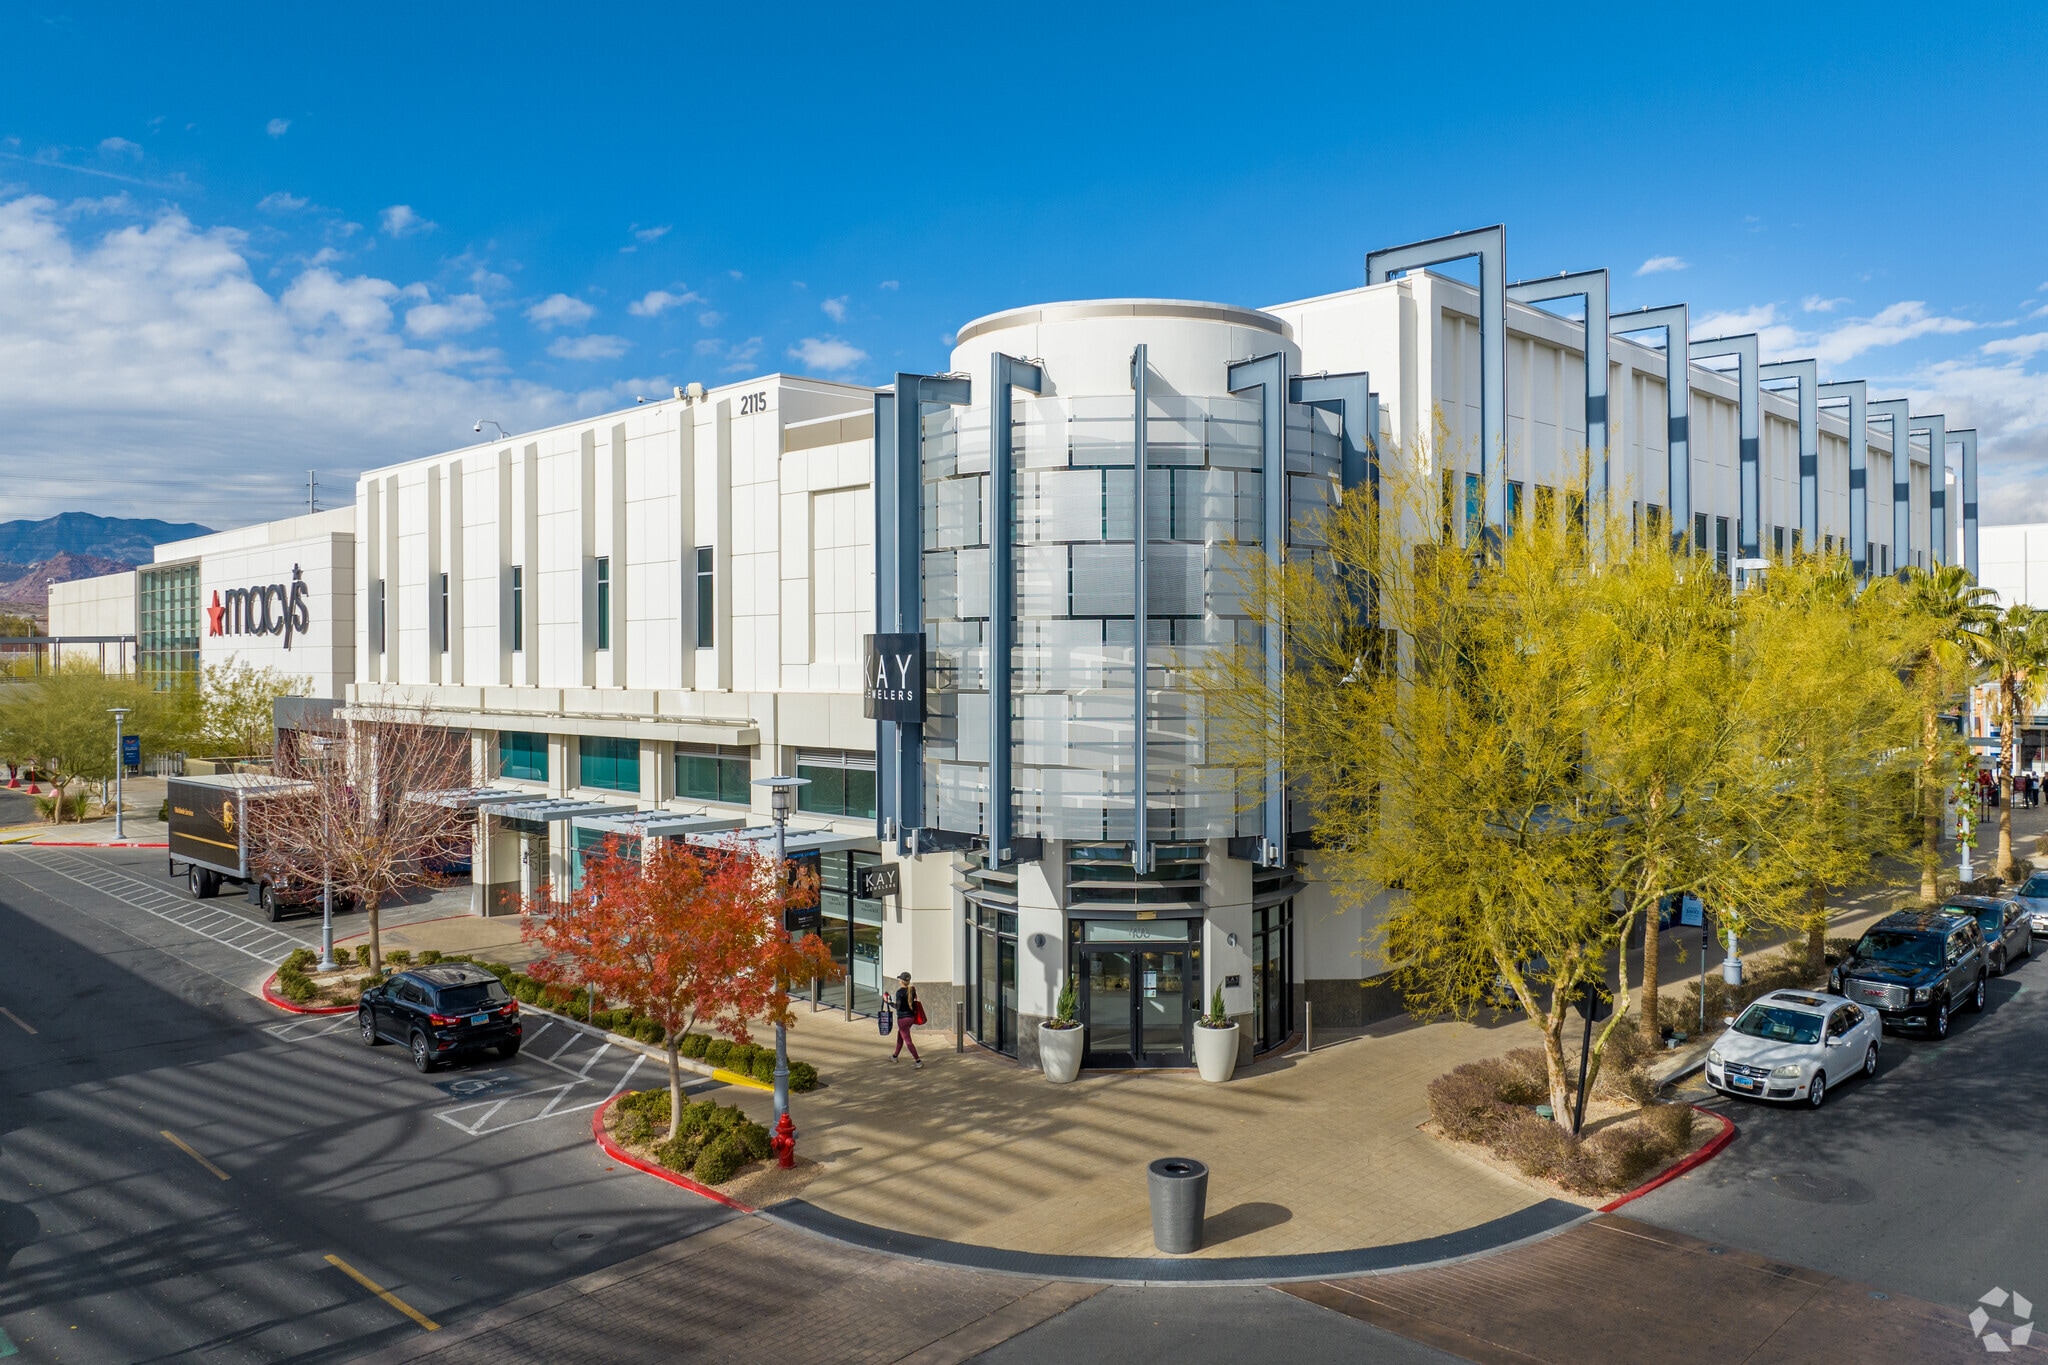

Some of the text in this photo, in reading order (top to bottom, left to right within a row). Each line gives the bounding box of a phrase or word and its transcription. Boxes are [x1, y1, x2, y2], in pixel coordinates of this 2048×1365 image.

[741, 391, 767, 415] 2115
[865, 654, 913, 689] KAY
[865, 870, 896, 888] KAY
